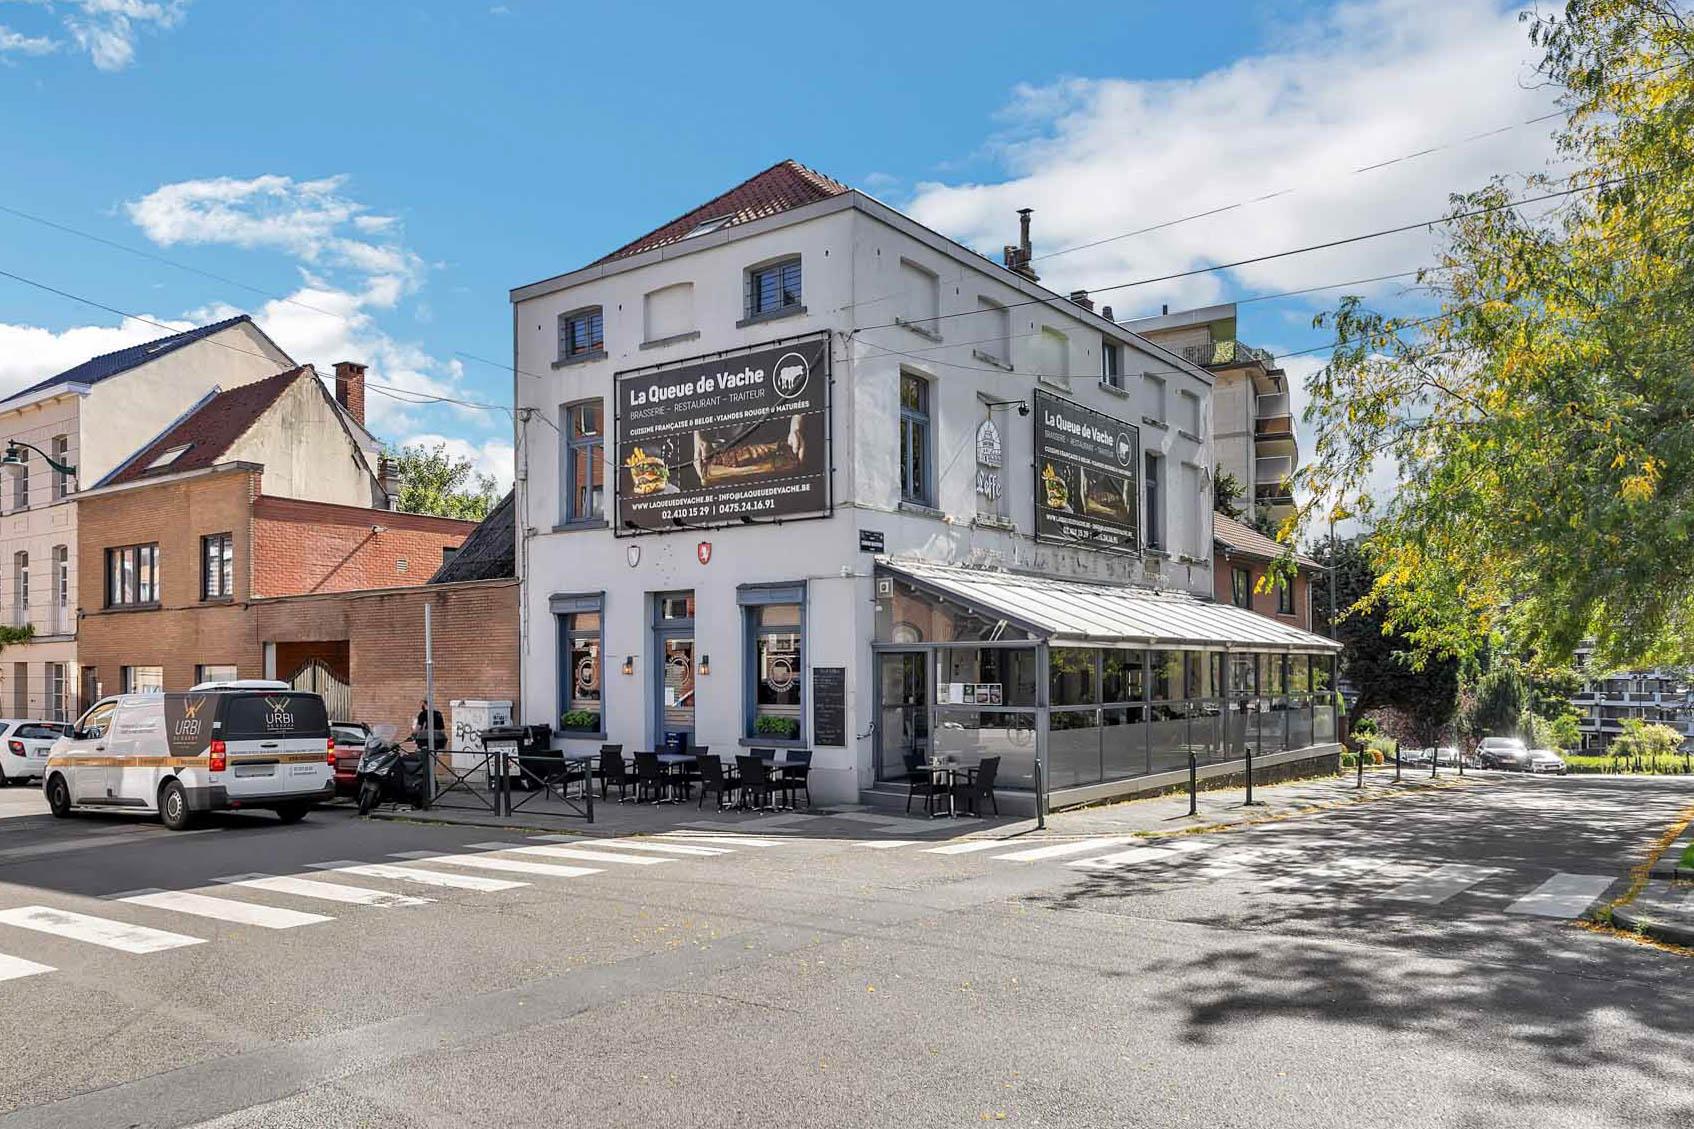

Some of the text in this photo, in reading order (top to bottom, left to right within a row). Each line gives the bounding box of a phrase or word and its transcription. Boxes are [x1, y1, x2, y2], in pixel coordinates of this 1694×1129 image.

[630, 367, 764, 406] La Queue de Vache
[630, 406, 665, 420] BRASSERIE
[674, 396, 721, 412] RESTAURANT
[729, 388, 765, 403] TRAITEUR
[630, 425, 654, 436] CUISINE
[694, 415, 713, 426] BELGE
[1044, 410, 1114, 447] La Queue de Vache
[719, 499, 775, 514] 0475.24.16.91
[174, 719, 201, 736] URBI
[265, 712, 294, 724] URBI
